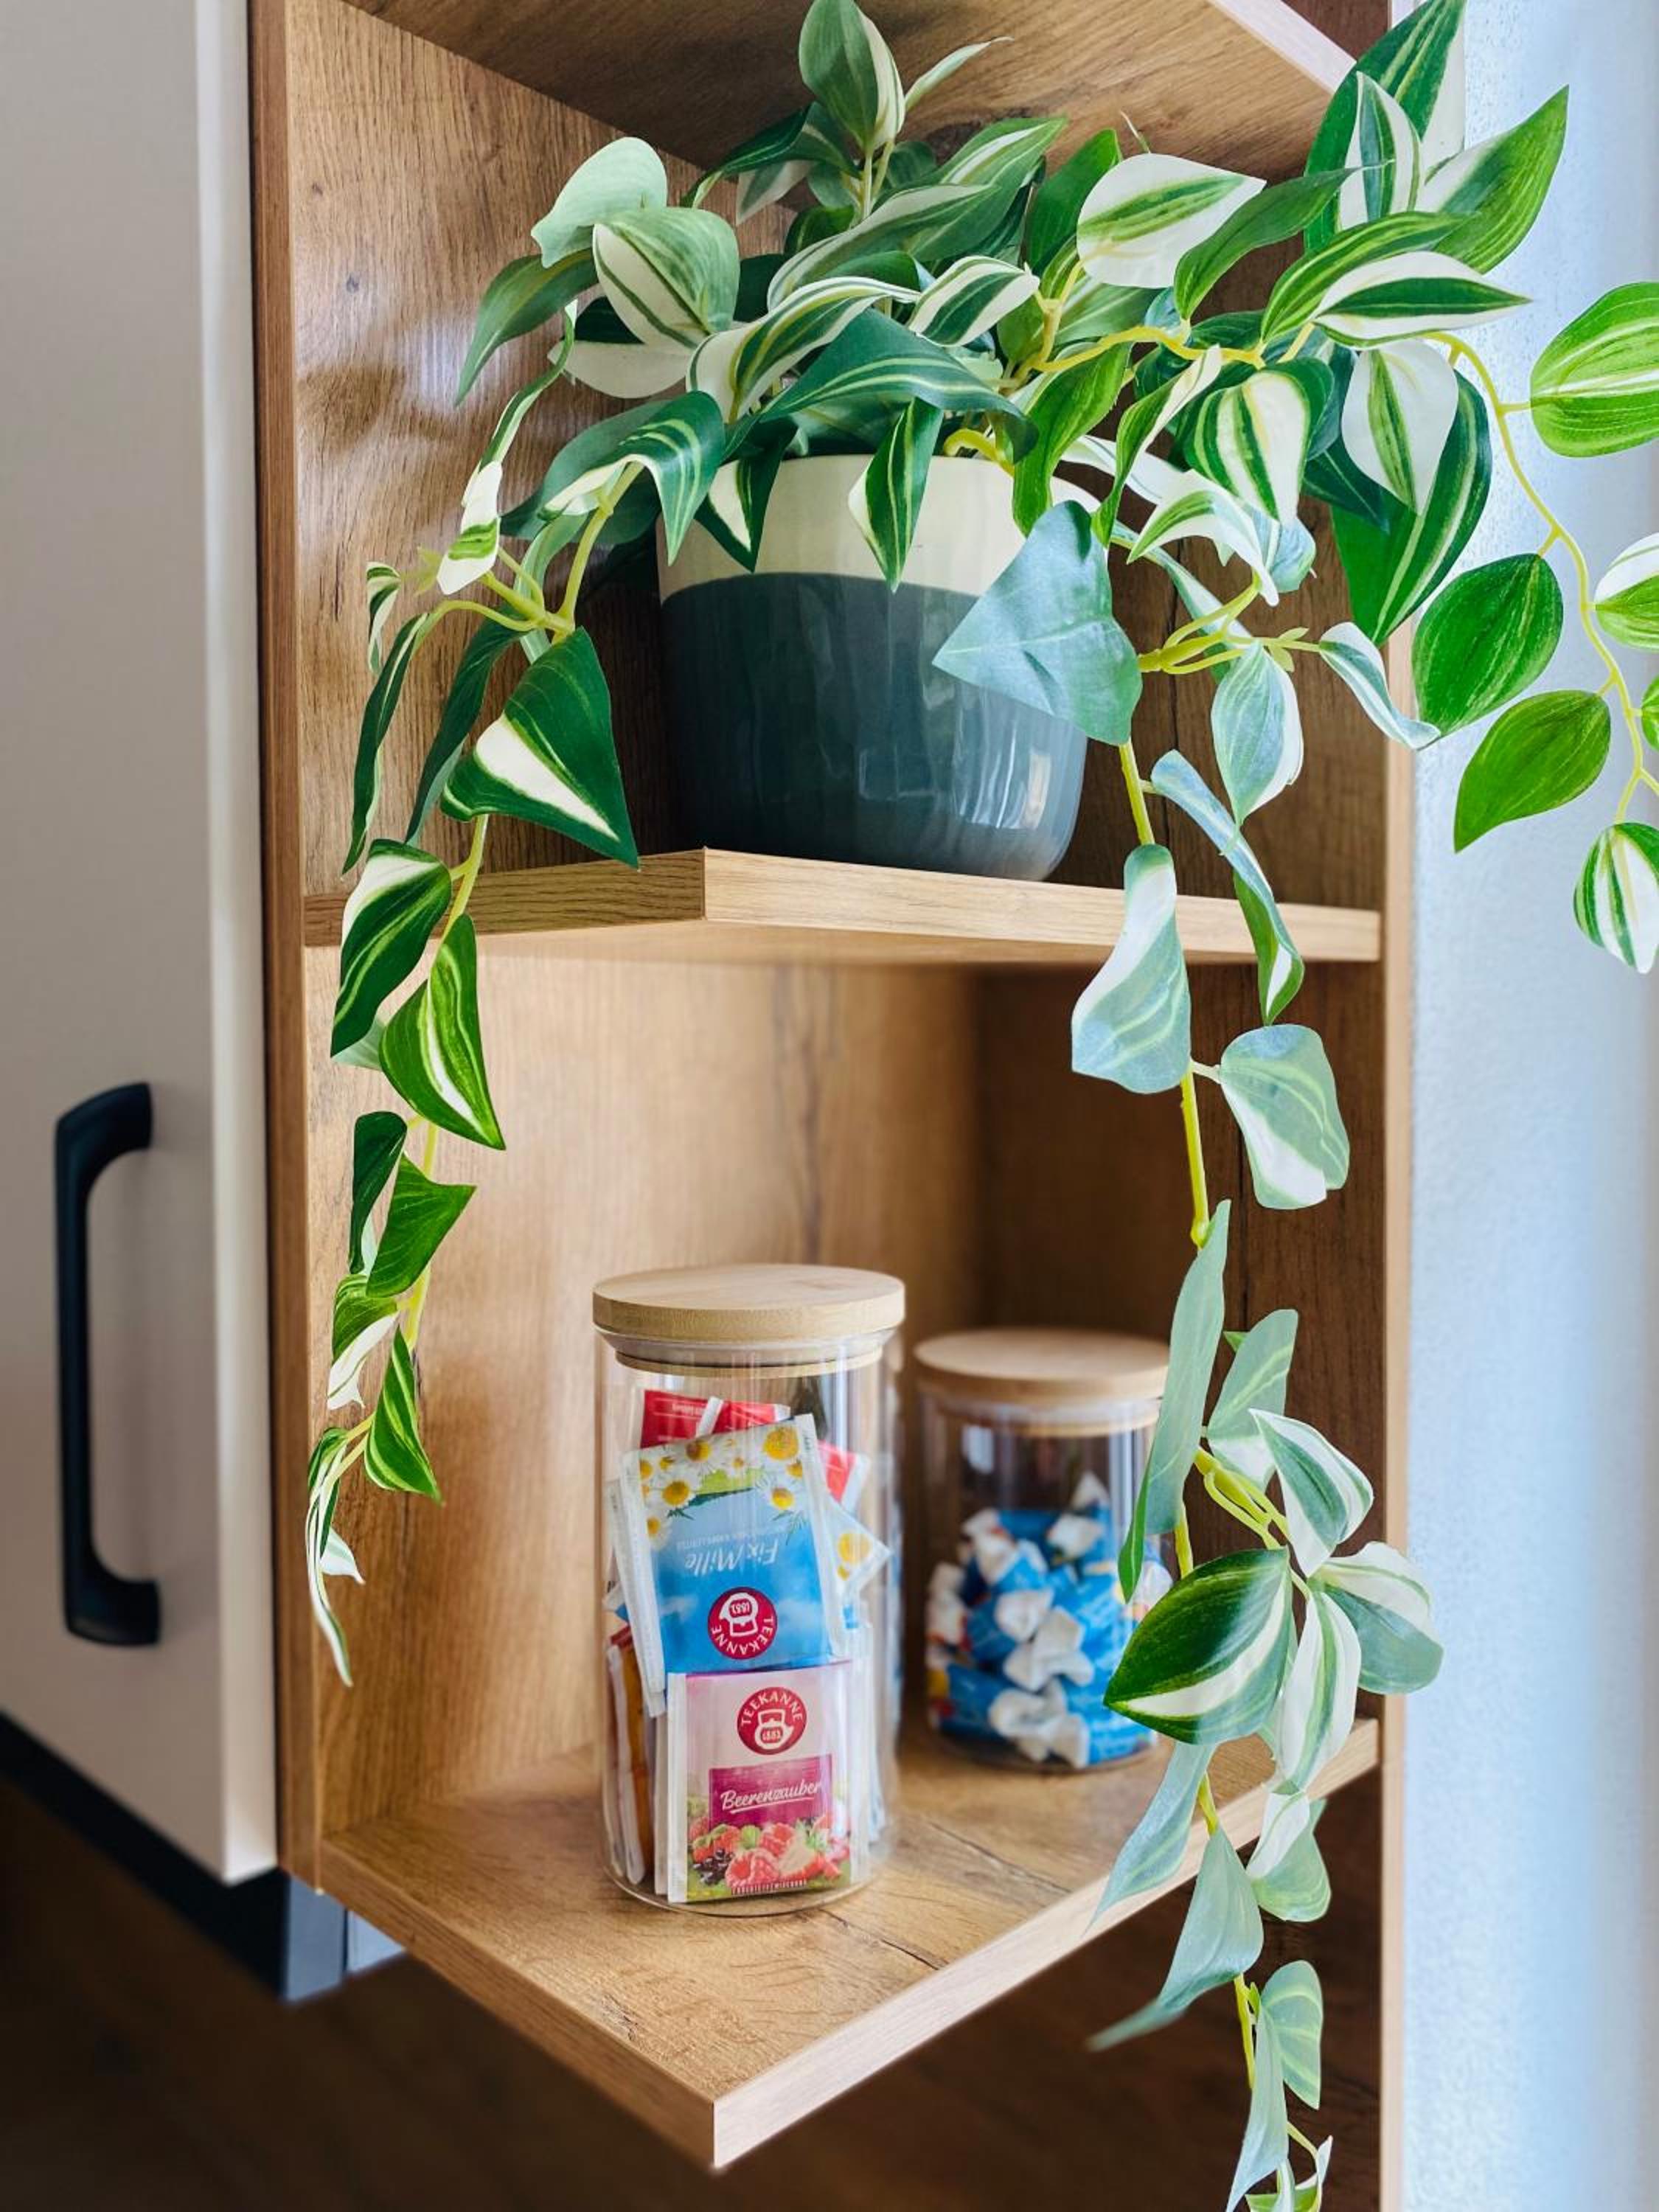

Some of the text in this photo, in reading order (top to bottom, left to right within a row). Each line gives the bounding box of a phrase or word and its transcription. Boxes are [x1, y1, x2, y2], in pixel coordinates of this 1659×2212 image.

[685, 1539, 779, 1576] Fix Mille
[710, 1615, 774, 1655] TEEKANNE
[740, 1691, 803, 1725] TEEKANNE
[720, 1779, 821, 1810] Beerenzauber
